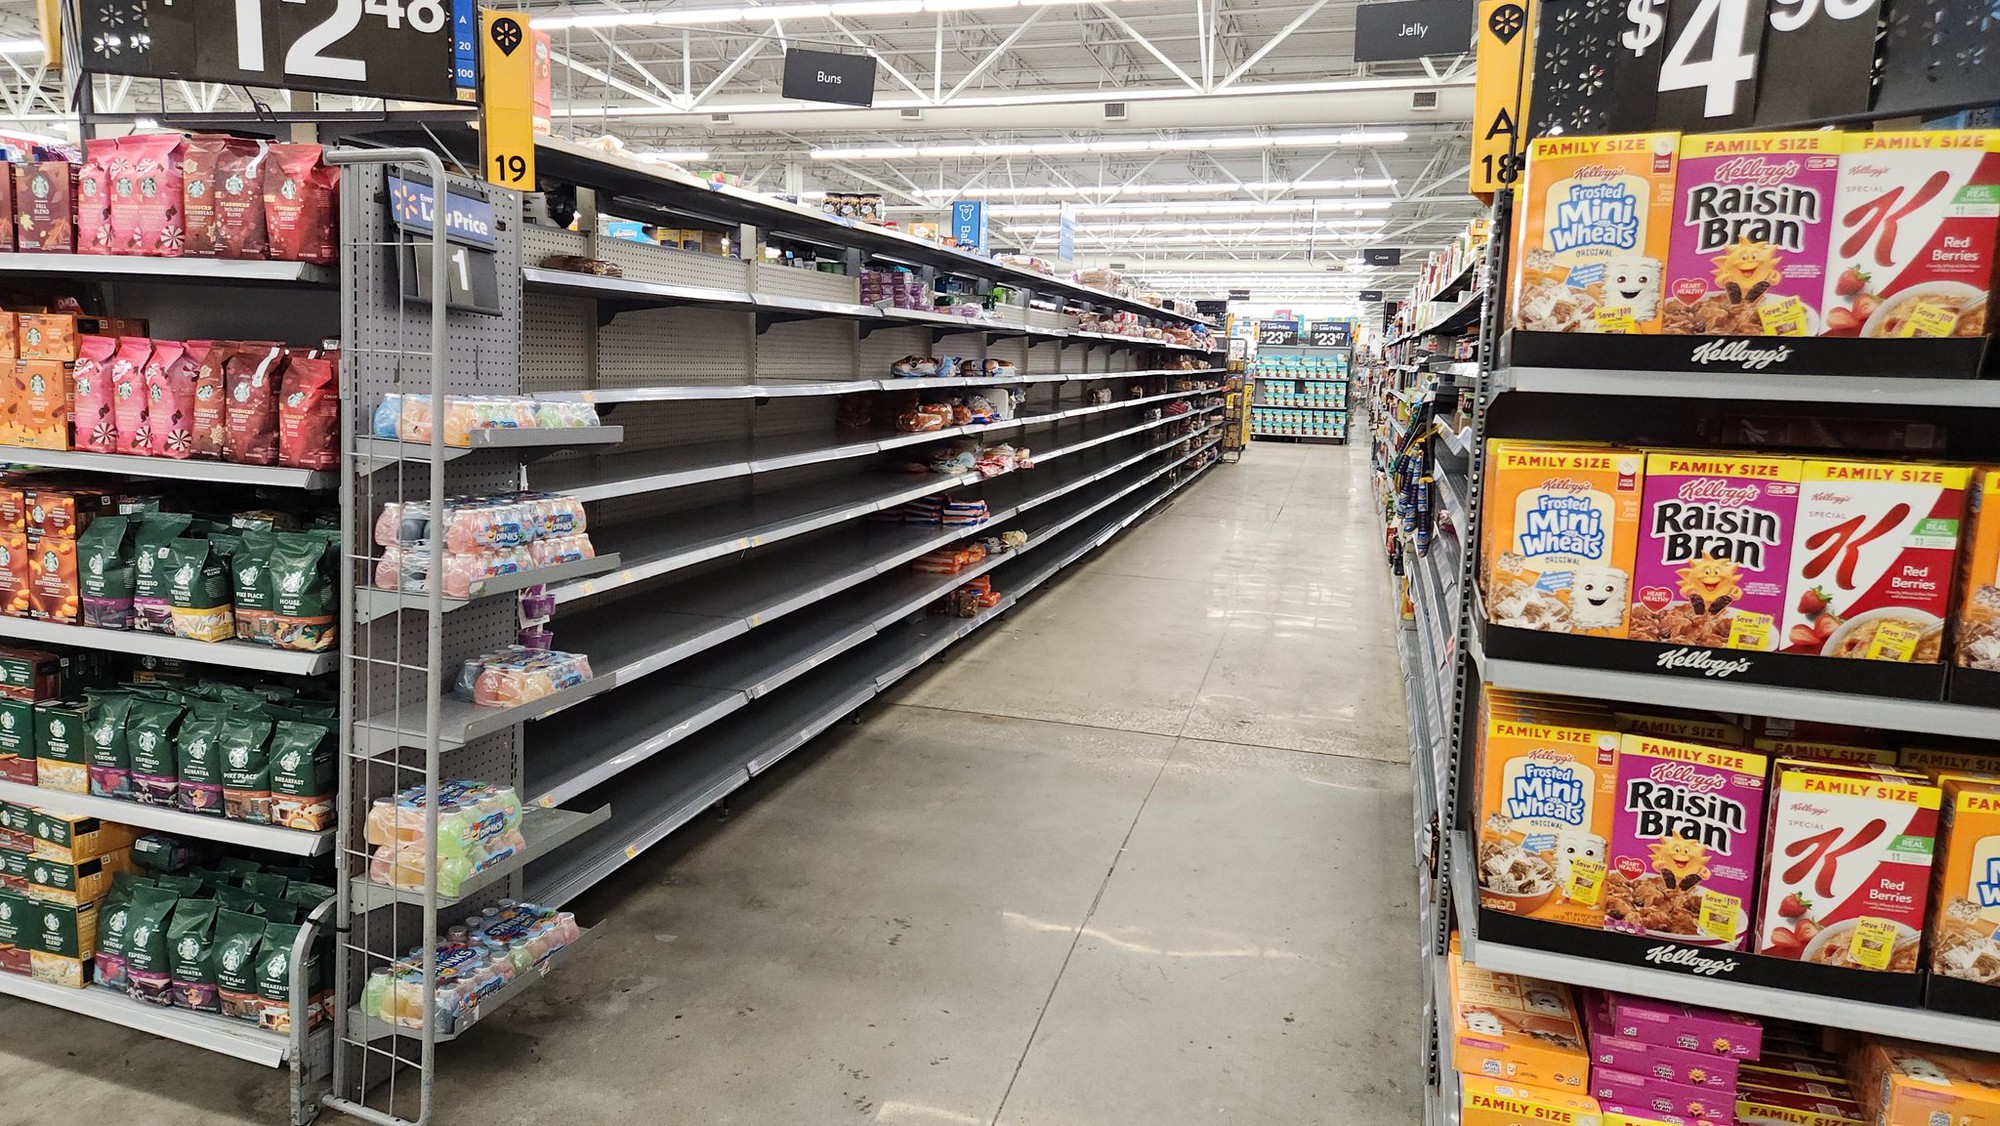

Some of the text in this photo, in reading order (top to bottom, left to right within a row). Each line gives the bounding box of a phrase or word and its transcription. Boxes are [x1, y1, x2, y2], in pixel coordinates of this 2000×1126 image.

[459, 16, 467, 24] A
[1398, 23, 1428, 39] Jelly
[459, 42, 471, 50] 20
[457, 69, 473, 78] 100
[817, 71, 842, 84] Buns
[1485, 107, 1519, 141] A
[1538, 139, 1647, 156] FAMILY SIZE
[1705, 138, 1819, 153] FAMILY SIZE
[1864, 135, 1985, 149] FAMILY SIZE
[495, 154, 526, 182] 19
[1481, 154, 1518, 184] 18
[1574, 165, 1624, 181] Kellogg's
[1715, 157, 1799, 185] Kellogg's
[1848, 165, 1889, 177] Kellogg's
[1571, 183, 1624, 201] Frosted
[1966, 190, 1991, 198] REAL
[1688, 185, 1817, 223] Raisin
[1560, 196, 1636, 228] Mini
[1839, 171, 1950, 267] K
[454, 211, 489, 235] Price
[1551, 218, 1638, 252] Wheats
[1699, 217, 1800, 250] Bran
[1943, 236, 1970, 248] Red
[1576, 249, 1613, 257] ORIGINAL
[1932, 249, 1979, 261] Berries
[452, 249, 469, 291] 1
[1598, 311, 1616, 319] Save
[1762, 307, 1781, 317] Save
[1917, 307, 1935, 318] Save
[1691, 338, 1790, 370] Kellogg's
[1508, 455, 1611, 469] FAMILY SIZE
[1669, 461, 1779, 476] FAMILY SIZE
[1826, 466, 1944, 483] FAMILY SIZE
[1542, 479, 1591, 494] Kellogg's
[1679, 478, 1759, 506] Kellogg's
[1539, 495, 1591, 512] Frosted
[1811, 492, 1851, 505] Kellogg's
[1528, 509, 1602, 536] Mini
[1653, 502, 1777, 543] Raisin
[1808, 511, 1847, 520] SPECIAL
[552, 522, 573, 532] DRINKS
[1925, 523, 1949, 531] REAL
[495, 531, 519, 542] DRINKS
[1520, 529, 1605, 559] Wheats
[1665, 533, 1760, 569] Bran
[1802, 502, 1910, 591] K
[1544, 556, 1580, 565] ORIGINAL
[1903, 565, 1928, 577] Red
[1891, 577, 1936, 590] Berries
[1735, 614, 1753, 623] Save
[1880, 626, 1899, 636] Save
[1657, 648, 1750, 677] Kellogg's
[1497, 725, 1592, 743] FAMILY SIZE
[1631, 720, 1726, 739] FAMILY SIZE
[135, 757, 160, 766] ESPRESSO
[1528, 748, 1574, 764] Kellogg's
[1641, 743, 1744, 769] FAMILY SIZE
[1908, 753, 1971, 768] FAMILY
[183, 768, 210, 777] SUMATRA
[1525, 764, 1573, 782] Frosted
[1650, 763, 1725, 791] Kellogg's
[275, 776, 305, 785] BREAKFAST
[1515, 776, 1583, 804] Mini
[1804, 778, 1919, 803] FAMILY SIZE
[1508, 798, 1585, 826] Wheats
[1628, 781, 1743, 830] Raisin
[1790, 802, 1829, 816] Kellogg's
[479, 821, 504, 838] DRINKS
[1530, 819, 1563, 829] ORIGINAL
[1788, 819, 1824, 830] SPECIAL
[1638, 810, 1727, 854] Bran
[1901, 839, 1924, 849] REAL
[1576, 860, 1592, 869] Save
[1621, 860, 1640, 868] HEART
[1782, 818, 1887, 898] K
[1618, 864, 1643, 873] HEALTHY
[1880, 878, 1904, 891] Red
[1705, 894, 1722, 903] Save
[1869, 889, 1913, 904] Berries
[1860, 919, 1879, 930] Save
[103, 940, 124, 949] VERONA
[128, 952, 151, 961] ESPRESSO
[1644, 945, 1735, 975] Kellogg's
[176, 968, 203, 977] SUMATRA
[260, 981, 289, 991] BREAKFAST
[1472, 1095, 1572, 1123] FAMILY SIZE
[1749, 1107, 1810, 1125] FAMILY
